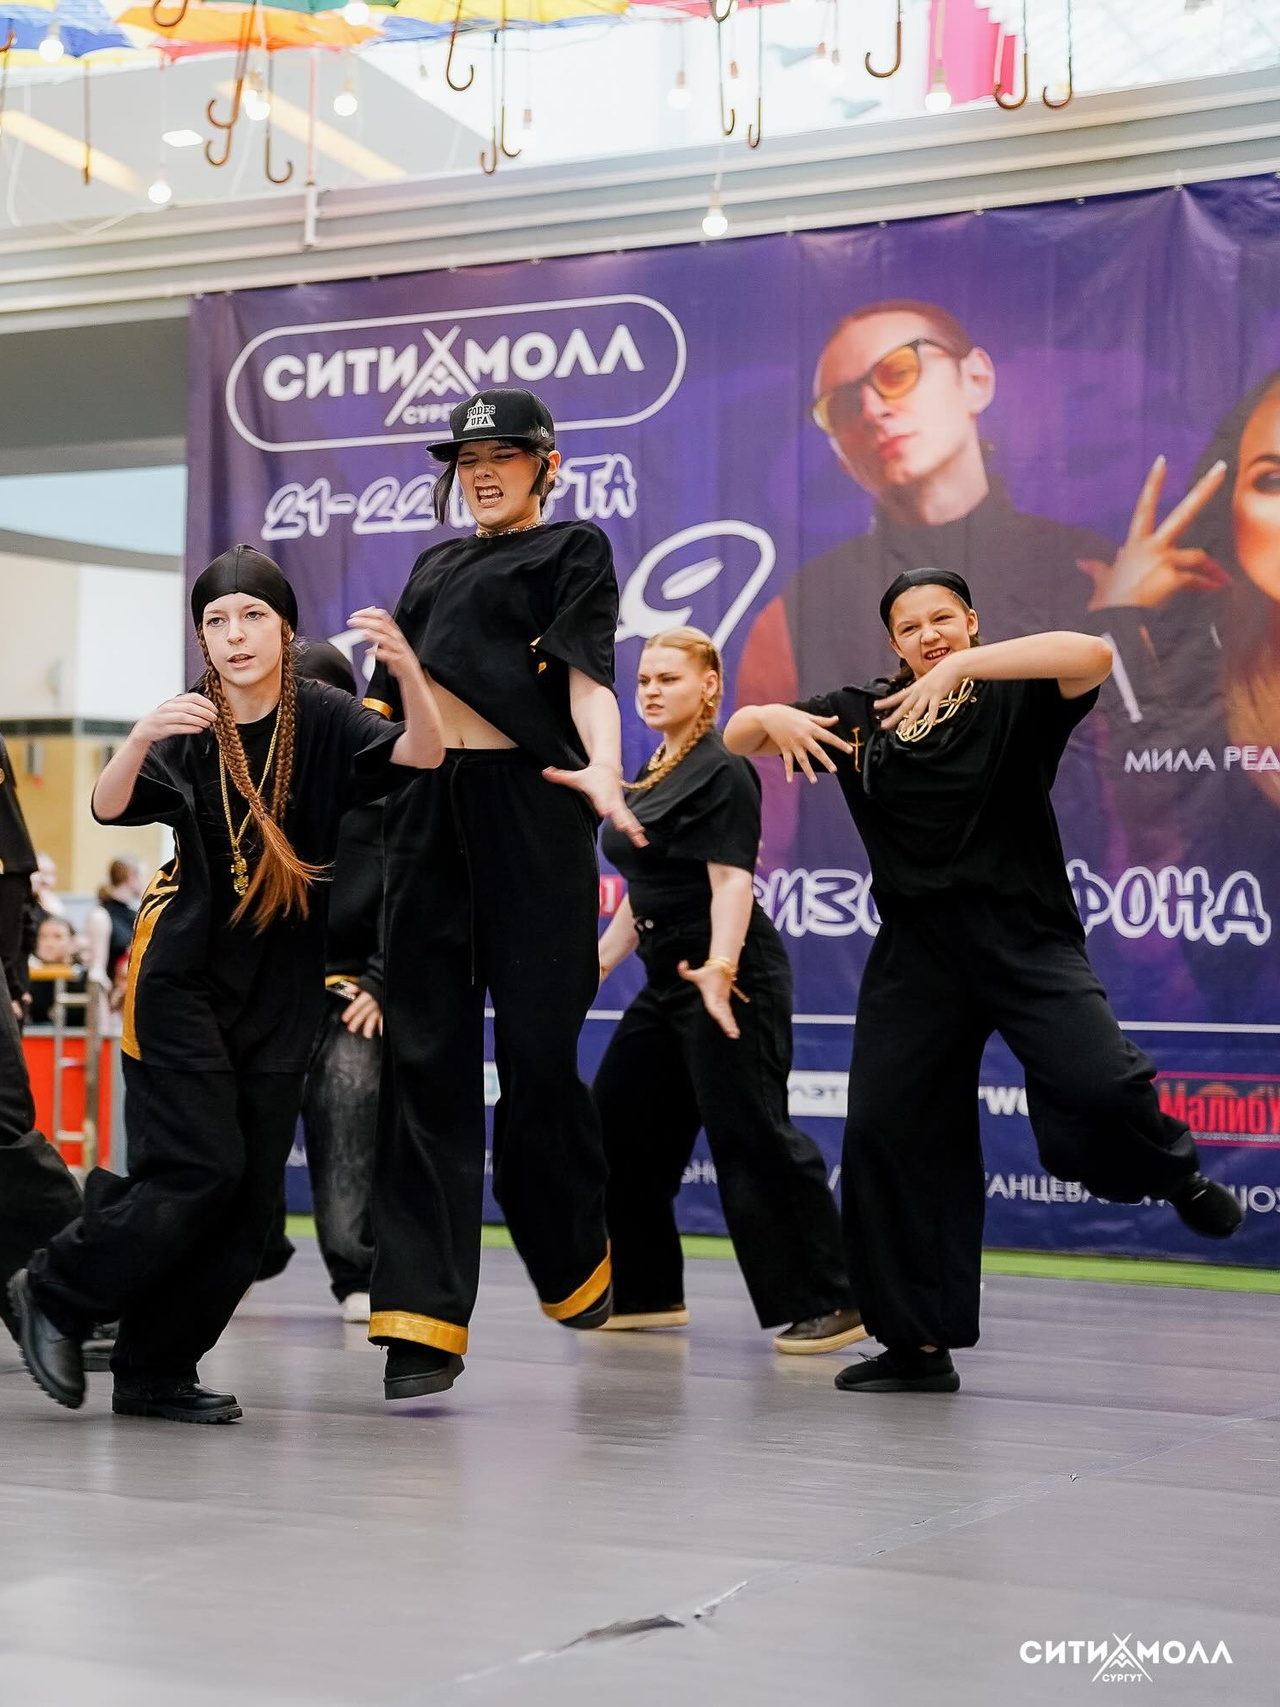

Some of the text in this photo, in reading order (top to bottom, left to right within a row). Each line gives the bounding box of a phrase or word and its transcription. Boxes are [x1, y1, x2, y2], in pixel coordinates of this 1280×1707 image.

[263, 324, 645, 401] СИТИ МОЛЛ
[471, 416, 490, 427] UFA
[261, 474, 438, 541] 21-22
[1124, 747, 1216, 773] МИЛА
